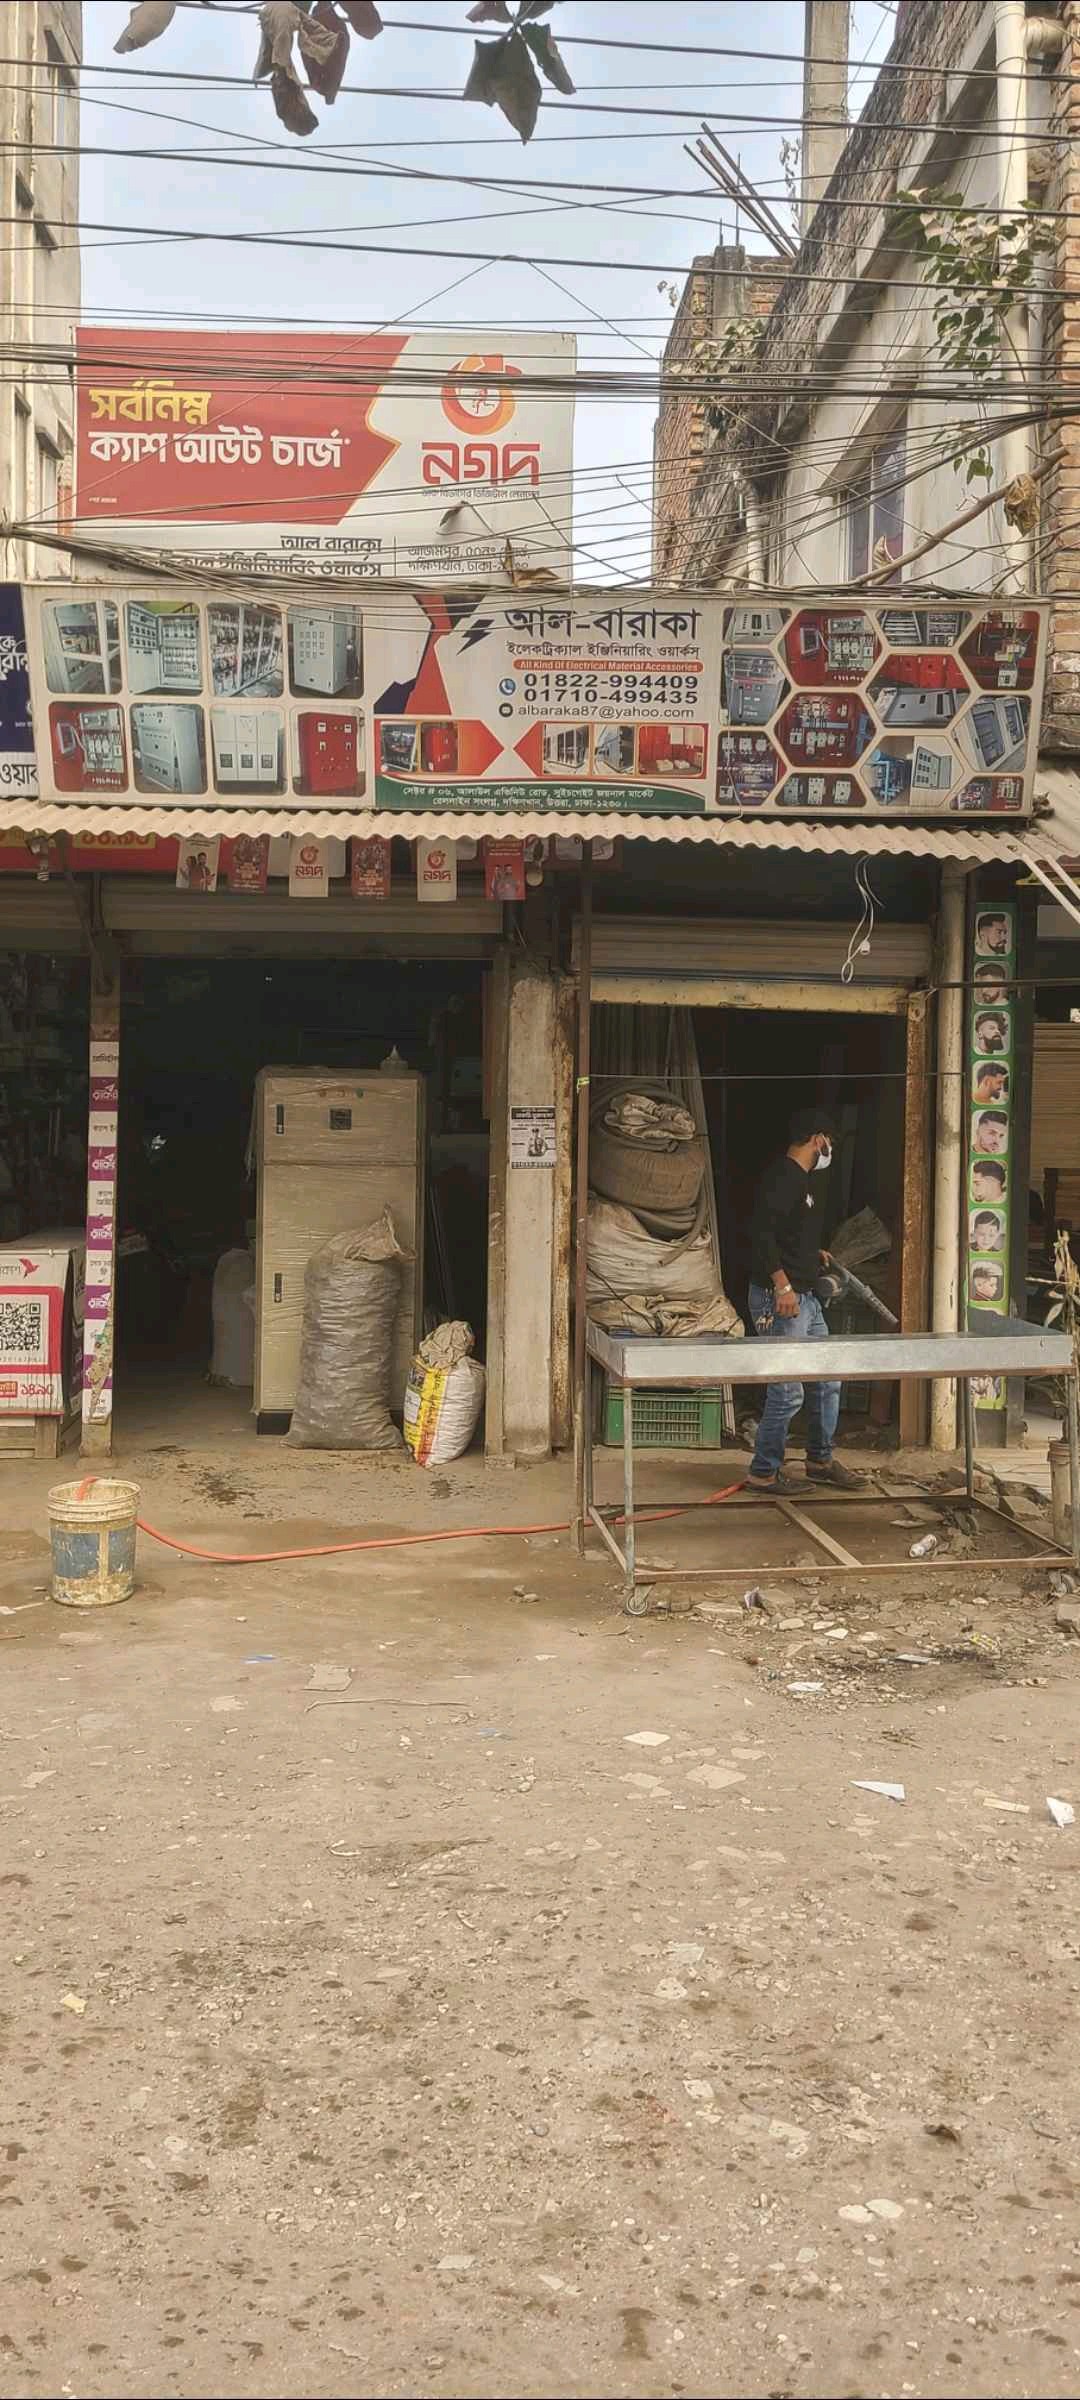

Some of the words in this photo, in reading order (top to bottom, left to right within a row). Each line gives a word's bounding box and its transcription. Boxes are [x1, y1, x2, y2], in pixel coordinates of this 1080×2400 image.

[88, 377, 212, 425] সর্বনিম্ন
[88, 431, 168, 463] ক্যাশ
[173, 424, 264, 465] আউট
[422, 442, 540, 486] নগদ
[280, 535, 320, 552] আল
[504, 606, 703, 640] আল-বারাকা
[506, 641, 582, 657] ইলেকট্রিক্যাল
[520, 661, 530, 669] All
[531, 661, 554, 670] Kind
[566, 661, 607, 671] Electrical
[608, 662, 644, 671] Material
[645, 662, 698, 672] Accessories
[524, 673, 699, 689] 01822-994409
[524, 689, 699, 704] 01710-499435
[518, 705, 695, 719] albaraka87@yahoo.com
